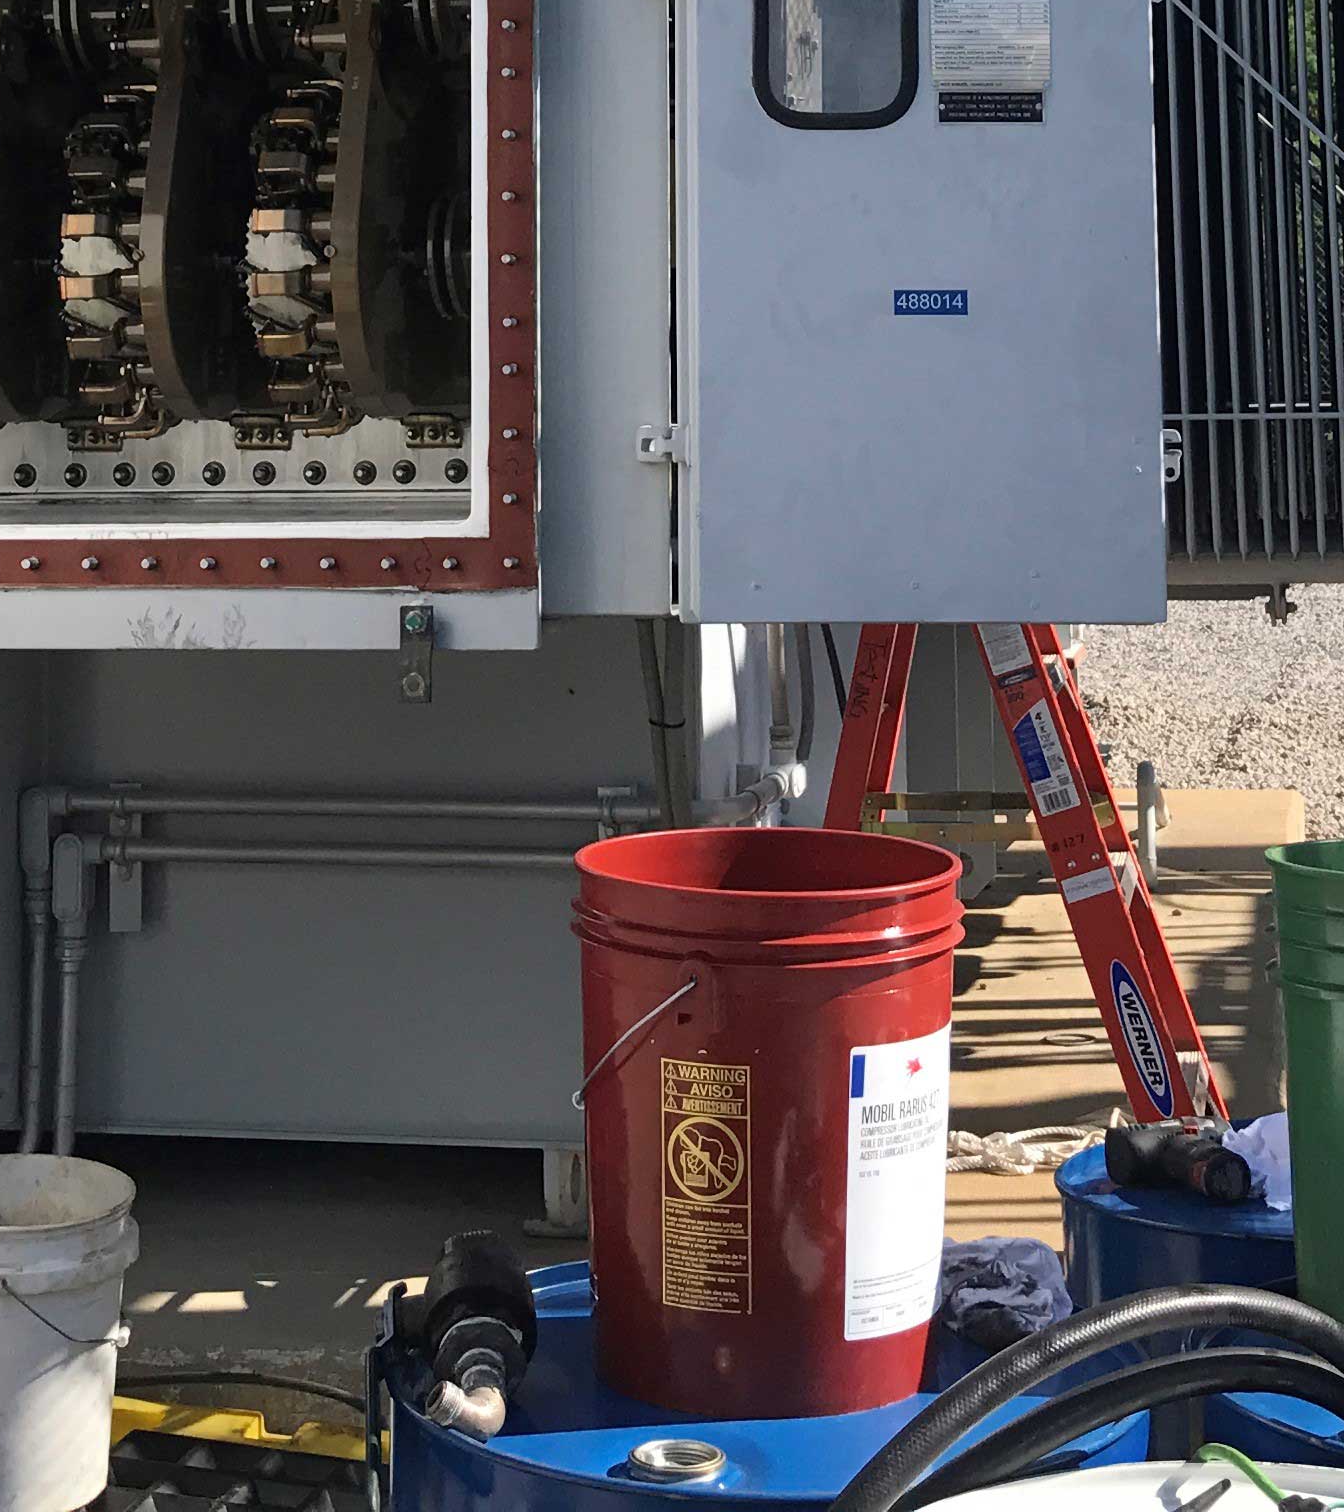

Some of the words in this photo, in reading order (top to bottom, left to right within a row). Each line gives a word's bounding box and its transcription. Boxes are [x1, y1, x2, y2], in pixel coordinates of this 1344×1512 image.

[896, 293, 964, 310] 488014
[1121, 991, 1164, 1088] WERNER
[677, 1064, 746, 1083] WARNING
[690, 1082, 734, 1098] AVISO
[861, 1102, 897, 1125] MOBIL
